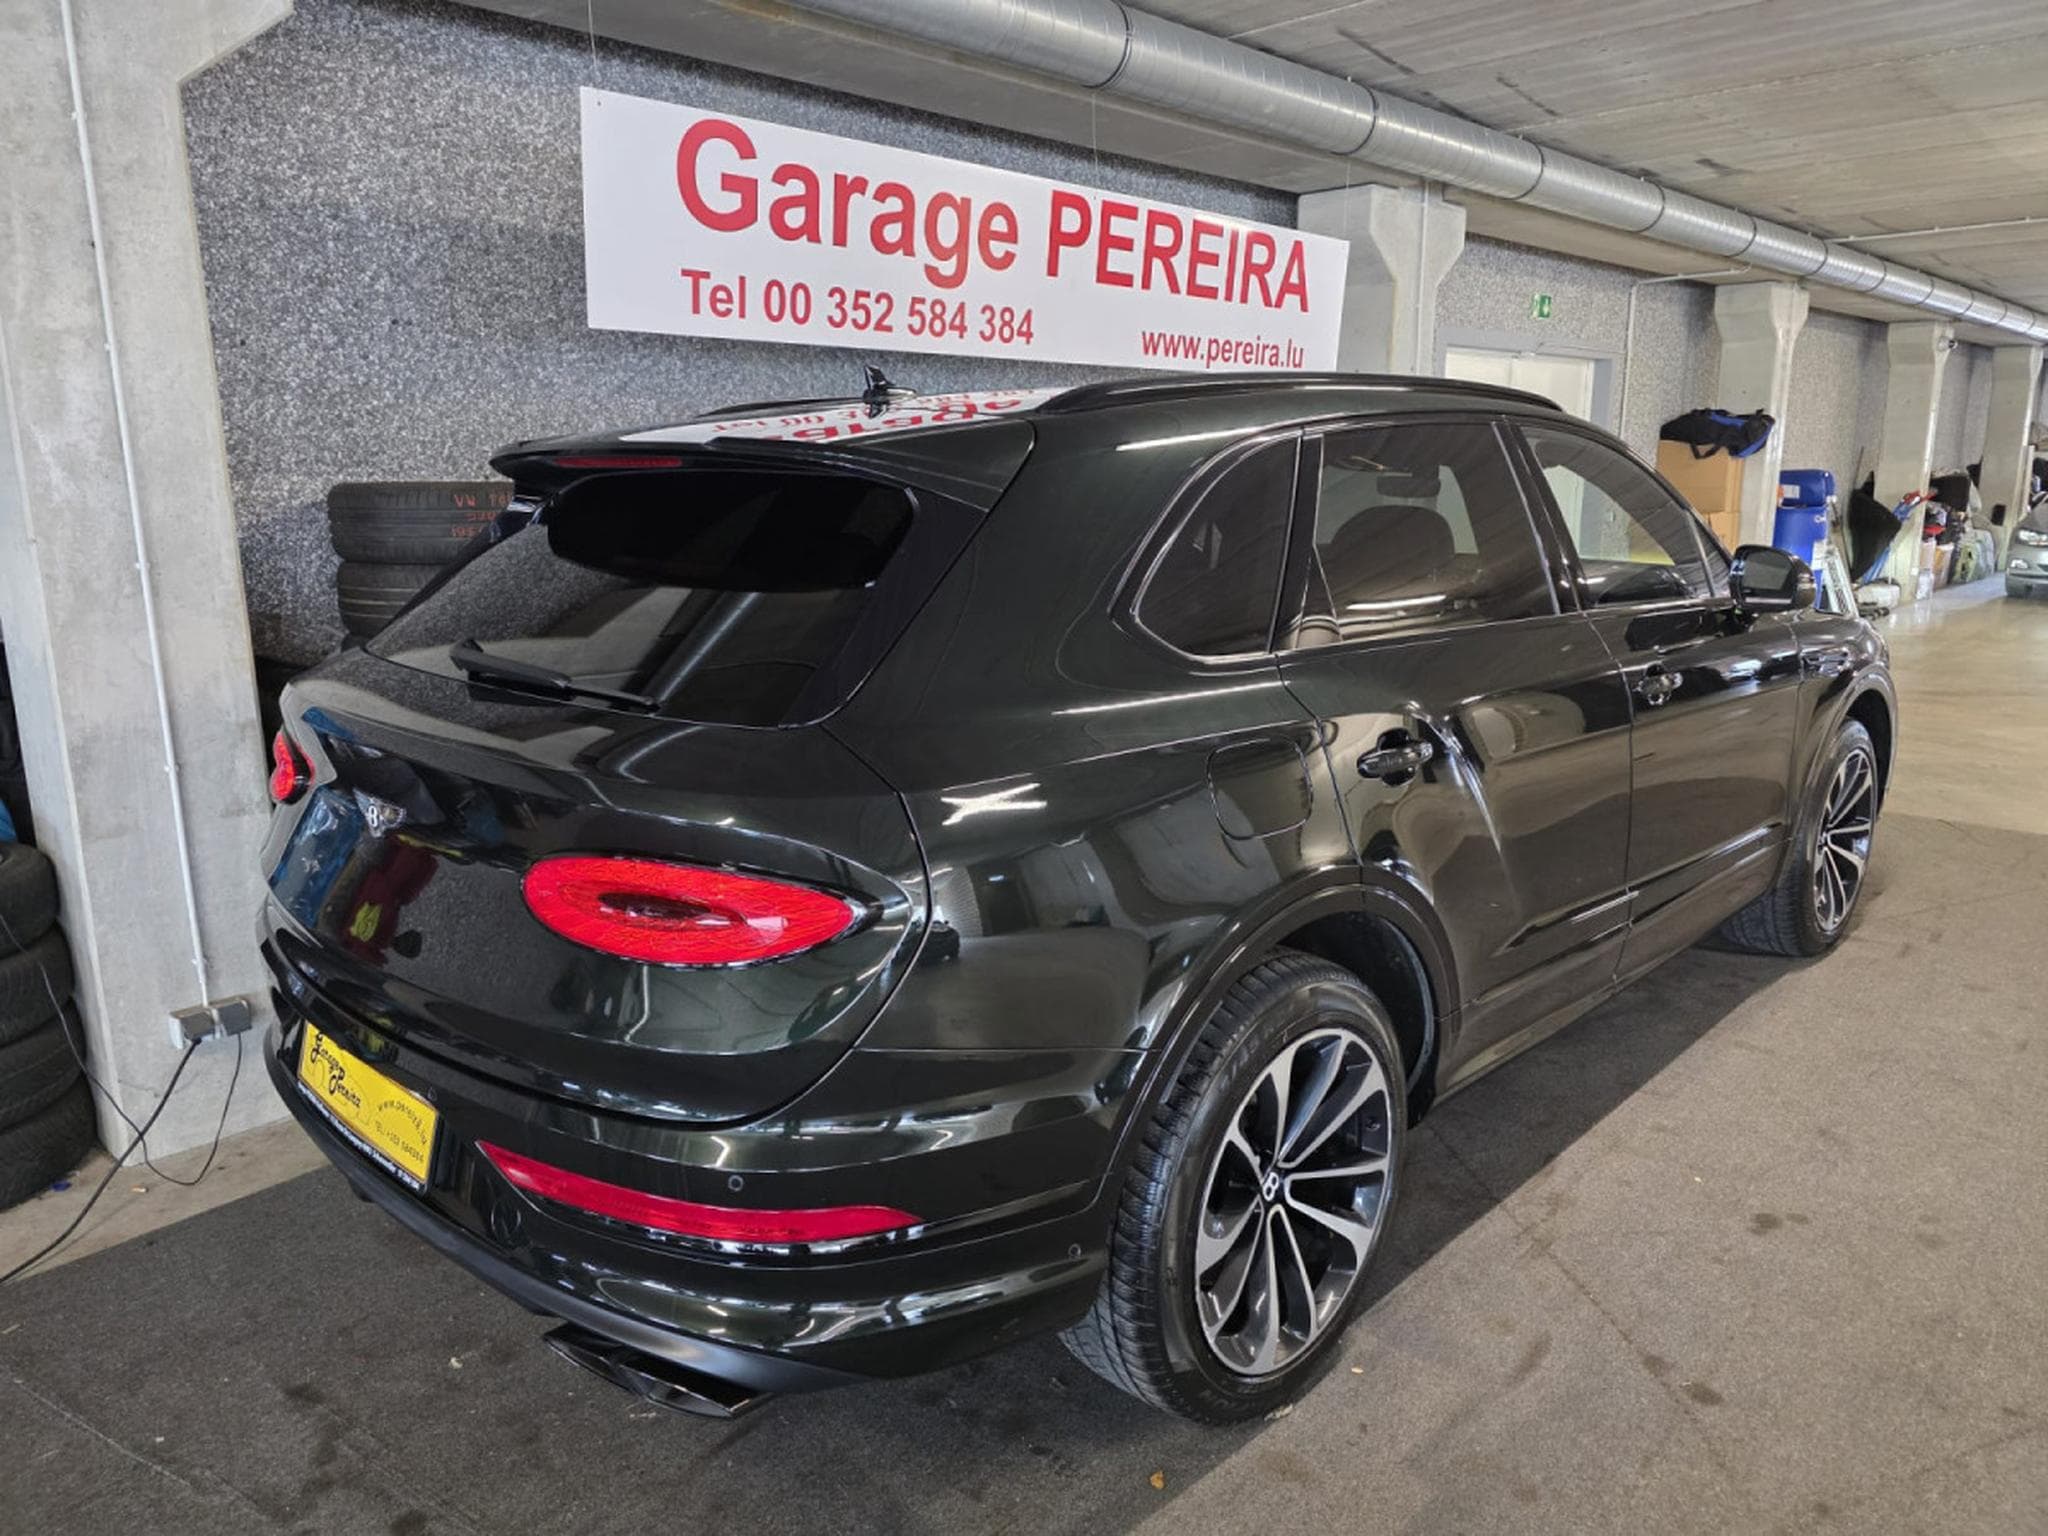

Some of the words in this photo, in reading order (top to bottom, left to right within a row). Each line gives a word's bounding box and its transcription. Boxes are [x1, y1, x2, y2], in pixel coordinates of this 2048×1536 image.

[676, 119, 1018, 289] Garage
[1047, 189, 1309, 313] PEREIRA
[681, 269, 746, 320] Tel
[763, 280, 812, 325] 00
[828, 288, 894, 332] 352
[908, 297, 967, 337] 584
[979, 305, 1033, 344] 384
[1141, 332, 1304, 369] www.pereira.lu
